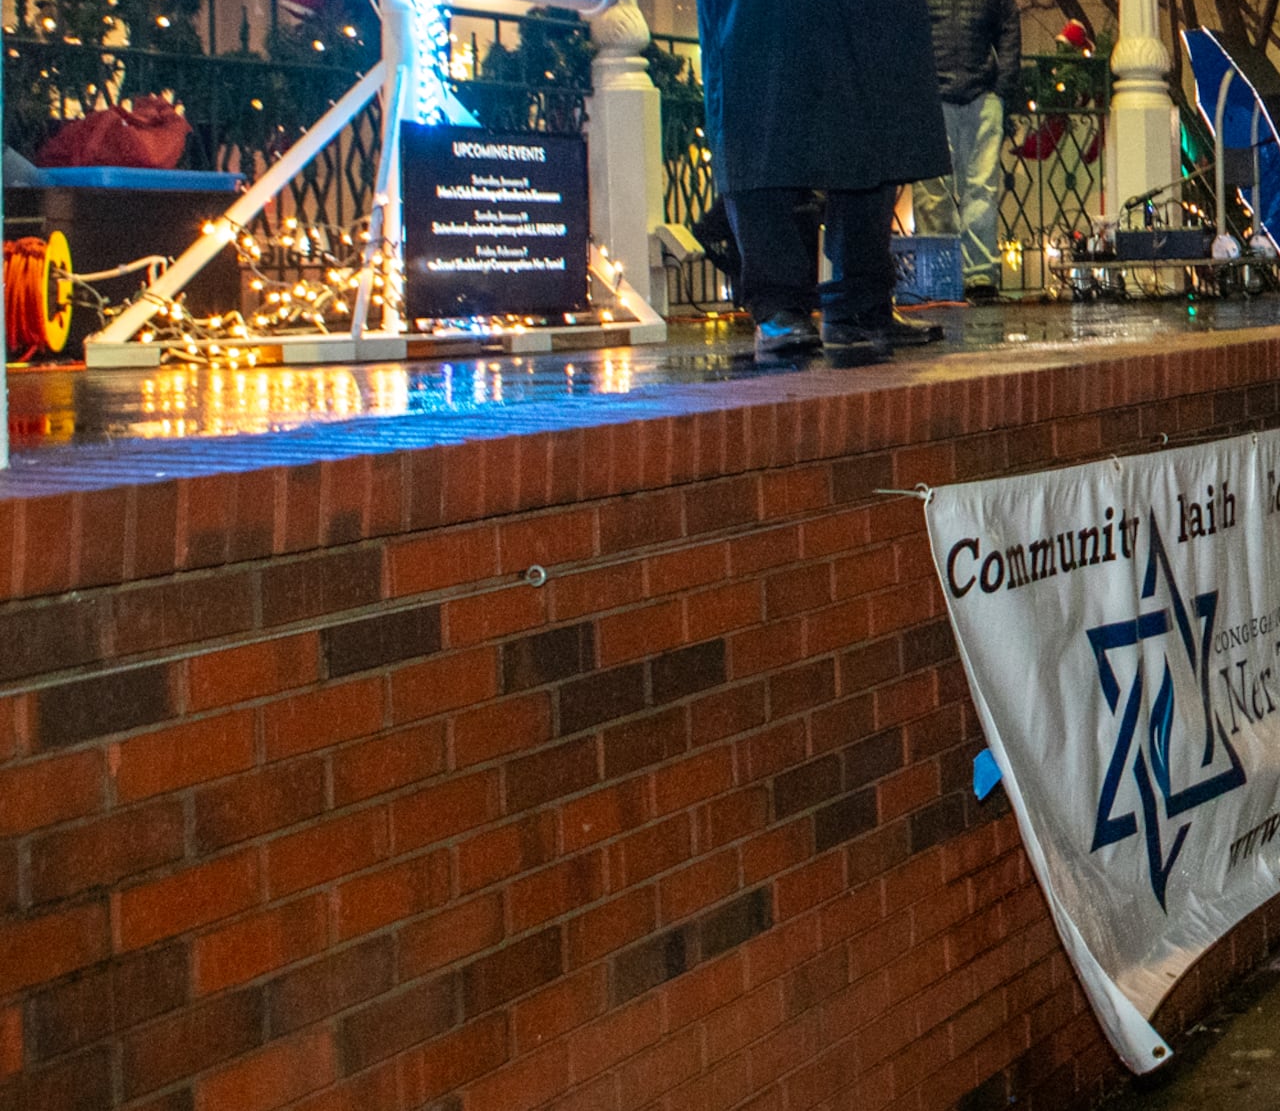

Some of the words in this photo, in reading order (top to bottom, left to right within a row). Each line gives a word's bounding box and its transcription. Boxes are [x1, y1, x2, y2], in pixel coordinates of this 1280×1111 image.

[452, 141, 508, 161] UPCOMING
[507, 144, 547, 163] EVENTS
[1177, 480, 1236, 543] aih
